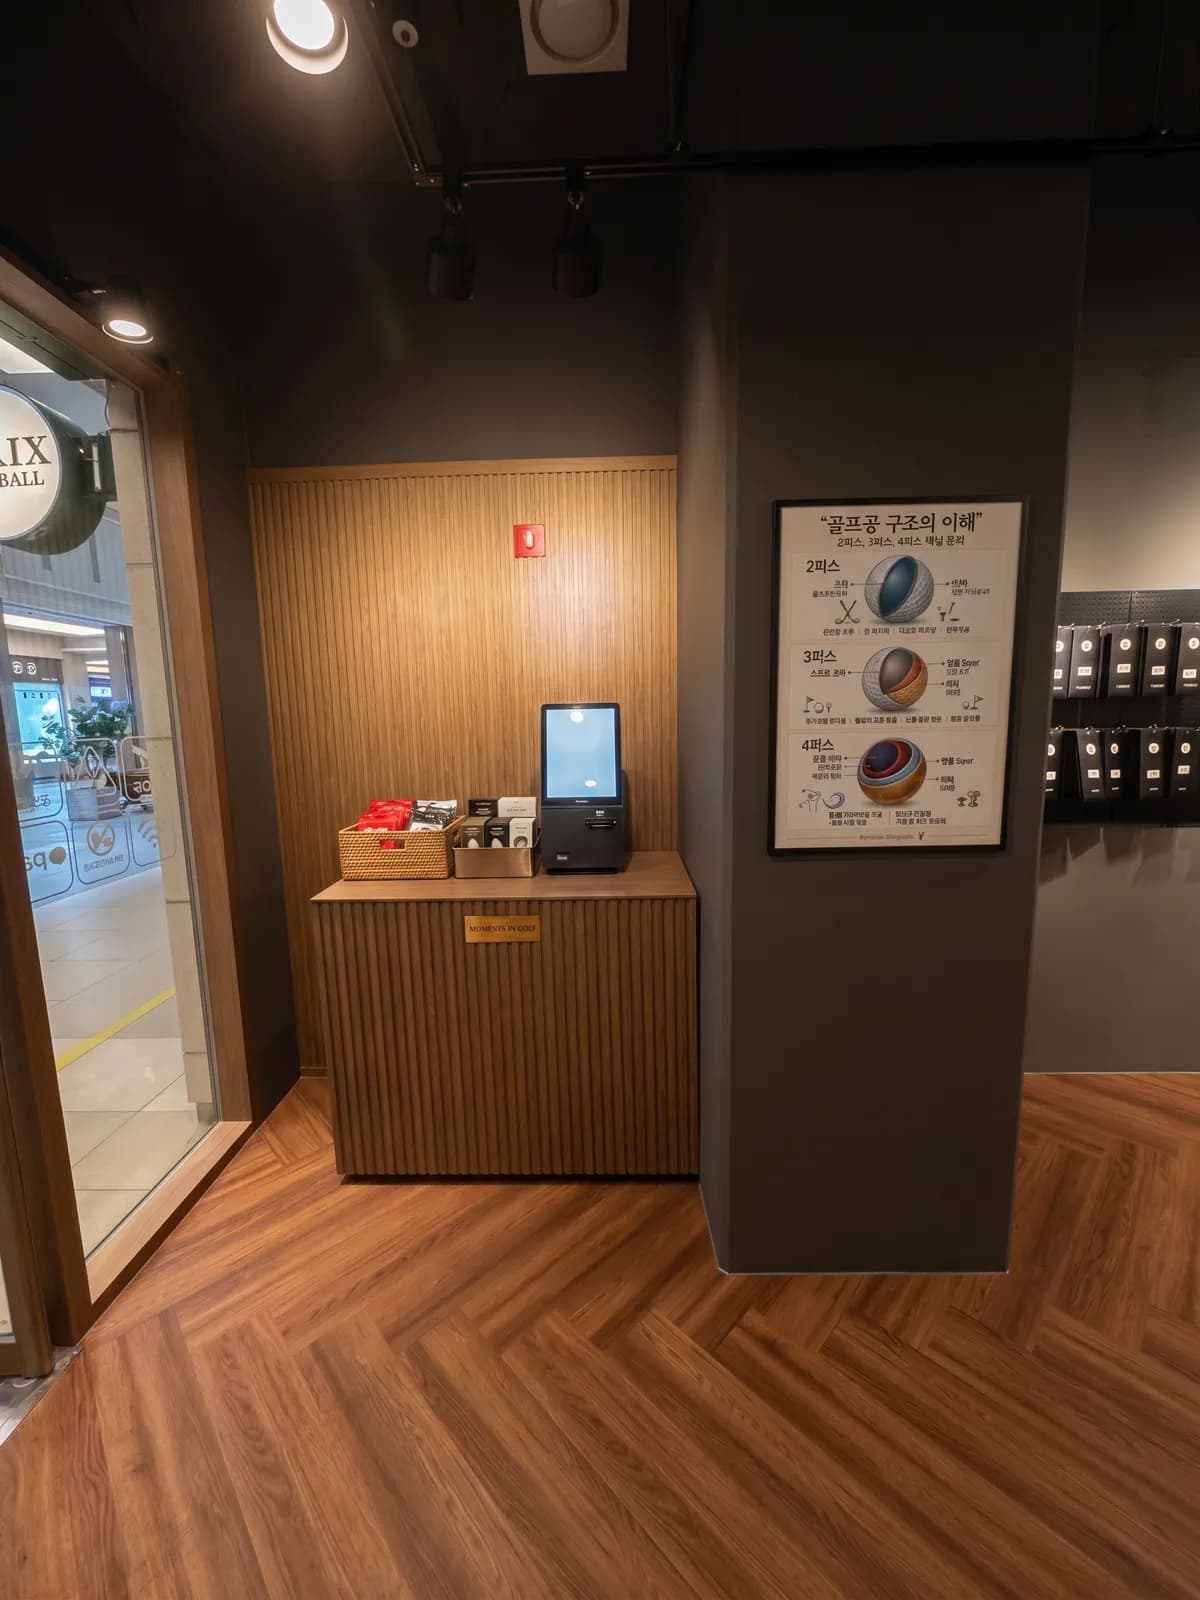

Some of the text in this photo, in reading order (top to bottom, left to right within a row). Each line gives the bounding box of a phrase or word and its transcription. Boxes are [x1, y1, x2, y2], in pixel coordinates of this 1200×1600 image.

[0, 435, 52, 467] IX
[0, 470, 45, 487] BALL
[885, 512, 935, 534] 구조의
[897, 536, 923, 547] 4피스
[806, 558, 841, 574] 2피스
[507, 924, 516, 932] IN
